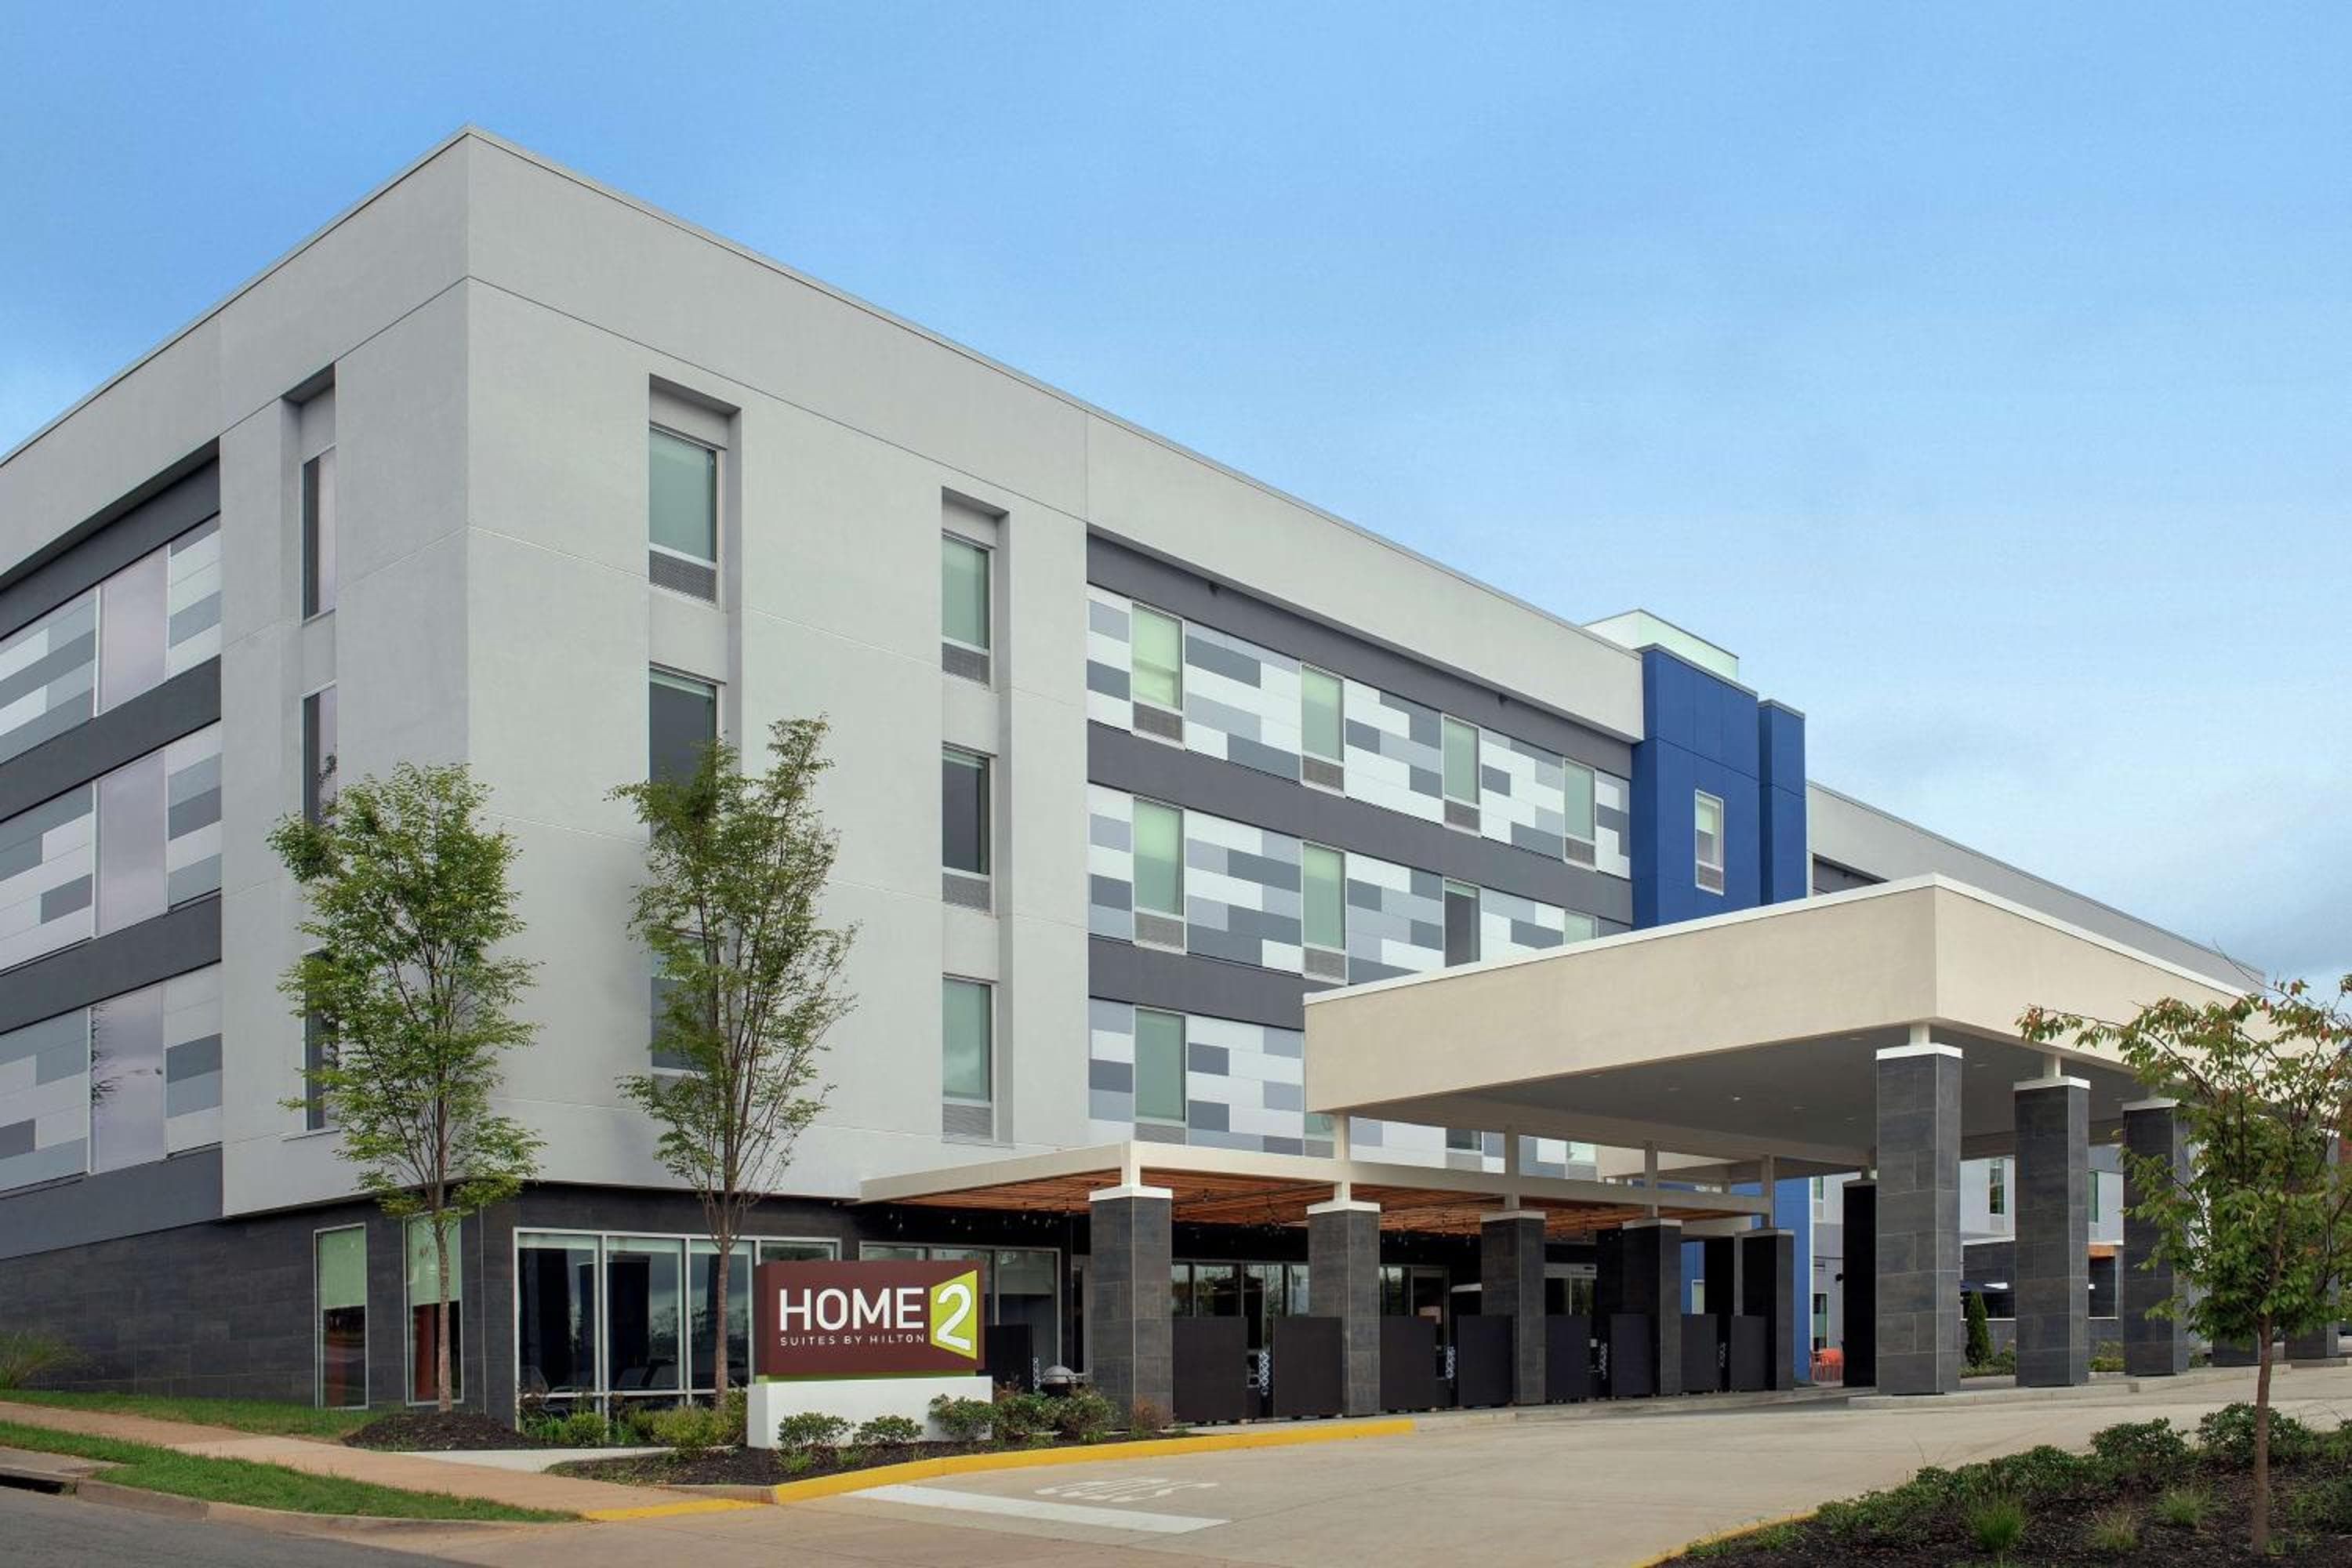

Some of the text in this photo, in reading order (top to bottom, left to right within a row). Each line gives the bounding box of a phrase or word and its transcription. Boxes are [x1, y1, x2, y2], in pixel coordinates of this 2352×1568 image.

[779, 1283, 971, 1351] HOME 2
[780, 1334, 926, 1346] SUITES BY HILTON
